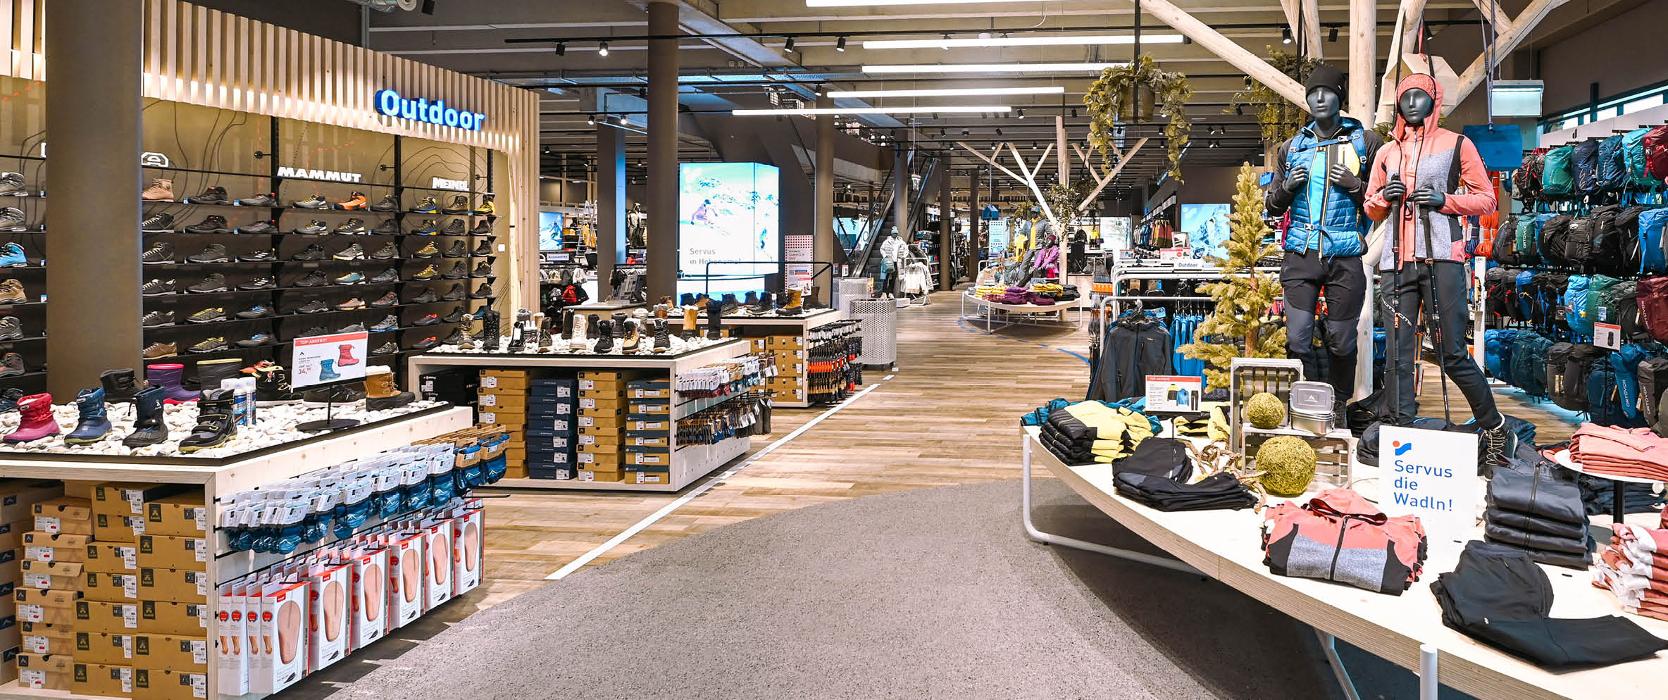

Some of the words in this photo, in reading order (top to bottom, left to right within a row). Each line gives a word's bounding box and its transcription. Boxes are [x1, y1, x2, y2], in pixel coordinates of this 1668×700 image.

[378, 89, 485, 131] Outdoor
[277, 167, 362, 183] MAMMUT
[689, 247, 716, 255] Servus
[1394, 459, 1453, 478] Servus
[1394, 476, 1418, 491] die
[1393, 491, 1452, 512] Wadln!
